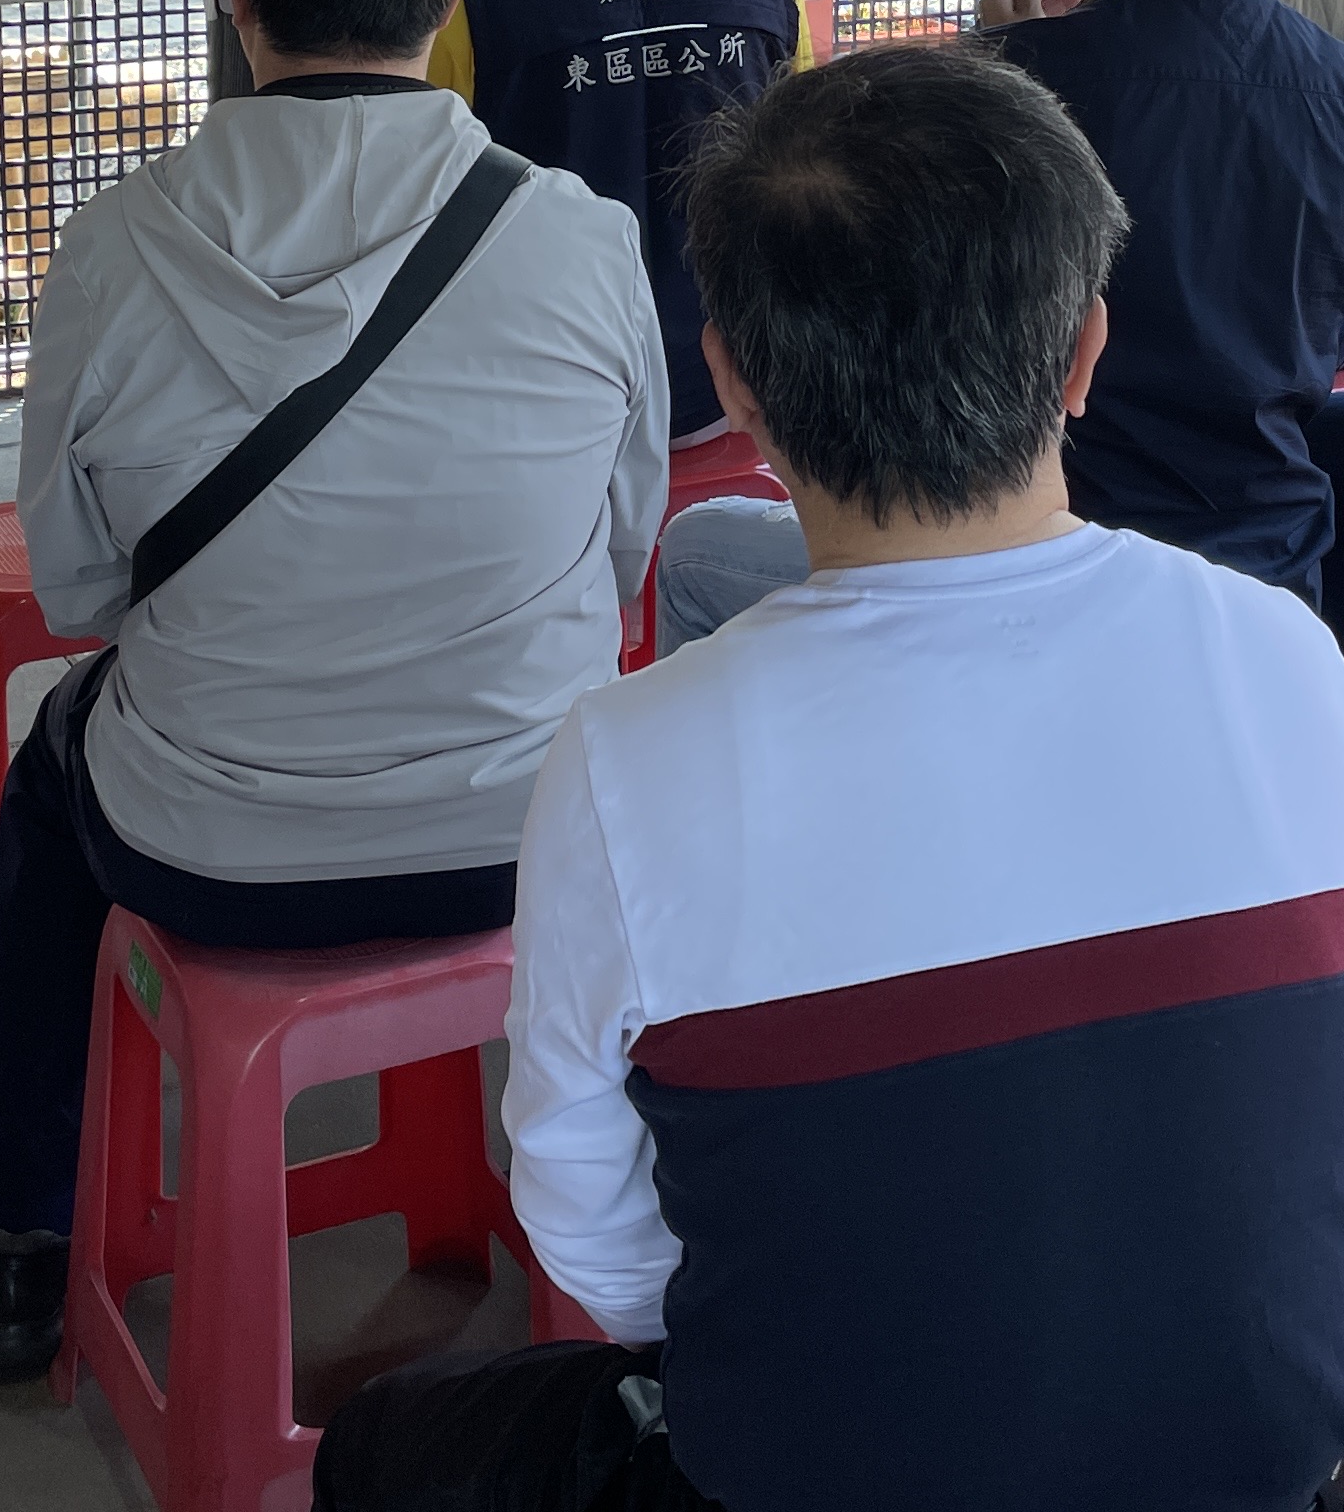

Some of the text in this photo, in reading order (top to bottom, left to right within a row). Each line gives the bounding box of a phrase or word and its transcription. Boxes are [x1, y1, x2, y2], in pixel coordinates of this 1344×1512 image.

[562, 32, 746, 92] 東區區公所
